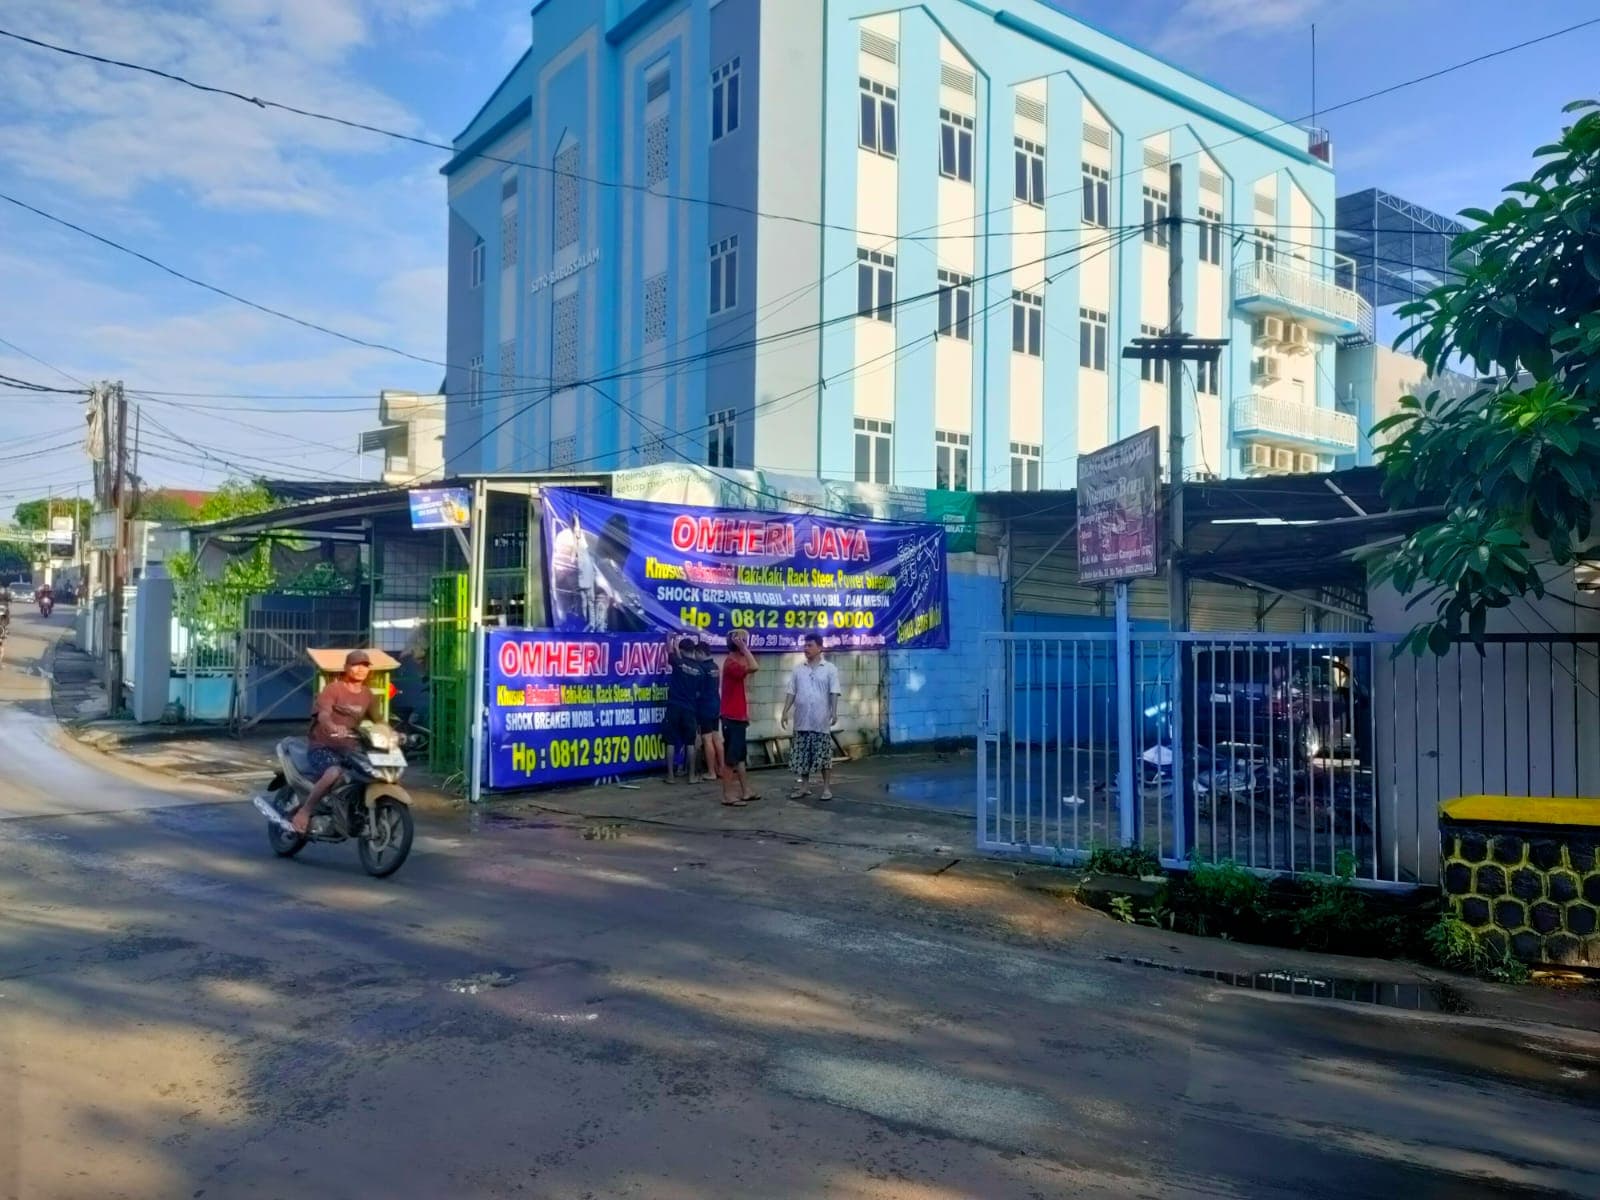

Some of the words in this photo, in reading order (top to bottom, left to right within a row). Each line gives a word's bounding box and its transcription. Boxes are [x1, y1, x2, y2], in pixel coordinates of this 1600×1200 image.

[672, 515, 795, 558] OMHERI
[805, 525, 870, 562] JAYA
[645, 556, 686, 580] Khusus
[787, 567, 809, 587] Rack
[837, 569, 864, 589] Power
[657, 586, 700, 602] SHOCK
[702, 588, 753, 605] BREAKER
[754, 591, 786, 606] MOBIL
[792, 593, 811, 607] CAT
[813, 593, 841, 607] MOBIL
[845, 594, 862, 608] DAN
[863, 594, 890, 608] MESIN
[680, 607, 711, 631] Hp
[731, 609, 778, 629] 0812
[785, 610, 828, 629] 9379
[833, 611, 874, 629] 0000
[499, 641, 610, 677] OMHERI
[615, 642, 673, 676] JAYA
[497, 685, 525, 706] Khusus
[596, 684, 613, 704] Rack
[633, 682, 651, 702] Power
[506, 713, 533, 731] SHOCK
[534, 711, 571, 730] BREAKER
[572, 709, 595, 728] MOBIL
[600, 708, 614, 727] CAT
[615, 707, 636, 725] MOBIL
[639, 707, 651, 724] DAN
[512, 742, 536, 777] Hp
[551, 739, 590, 769] 0812
[594, 736, 630, 765] 9379
